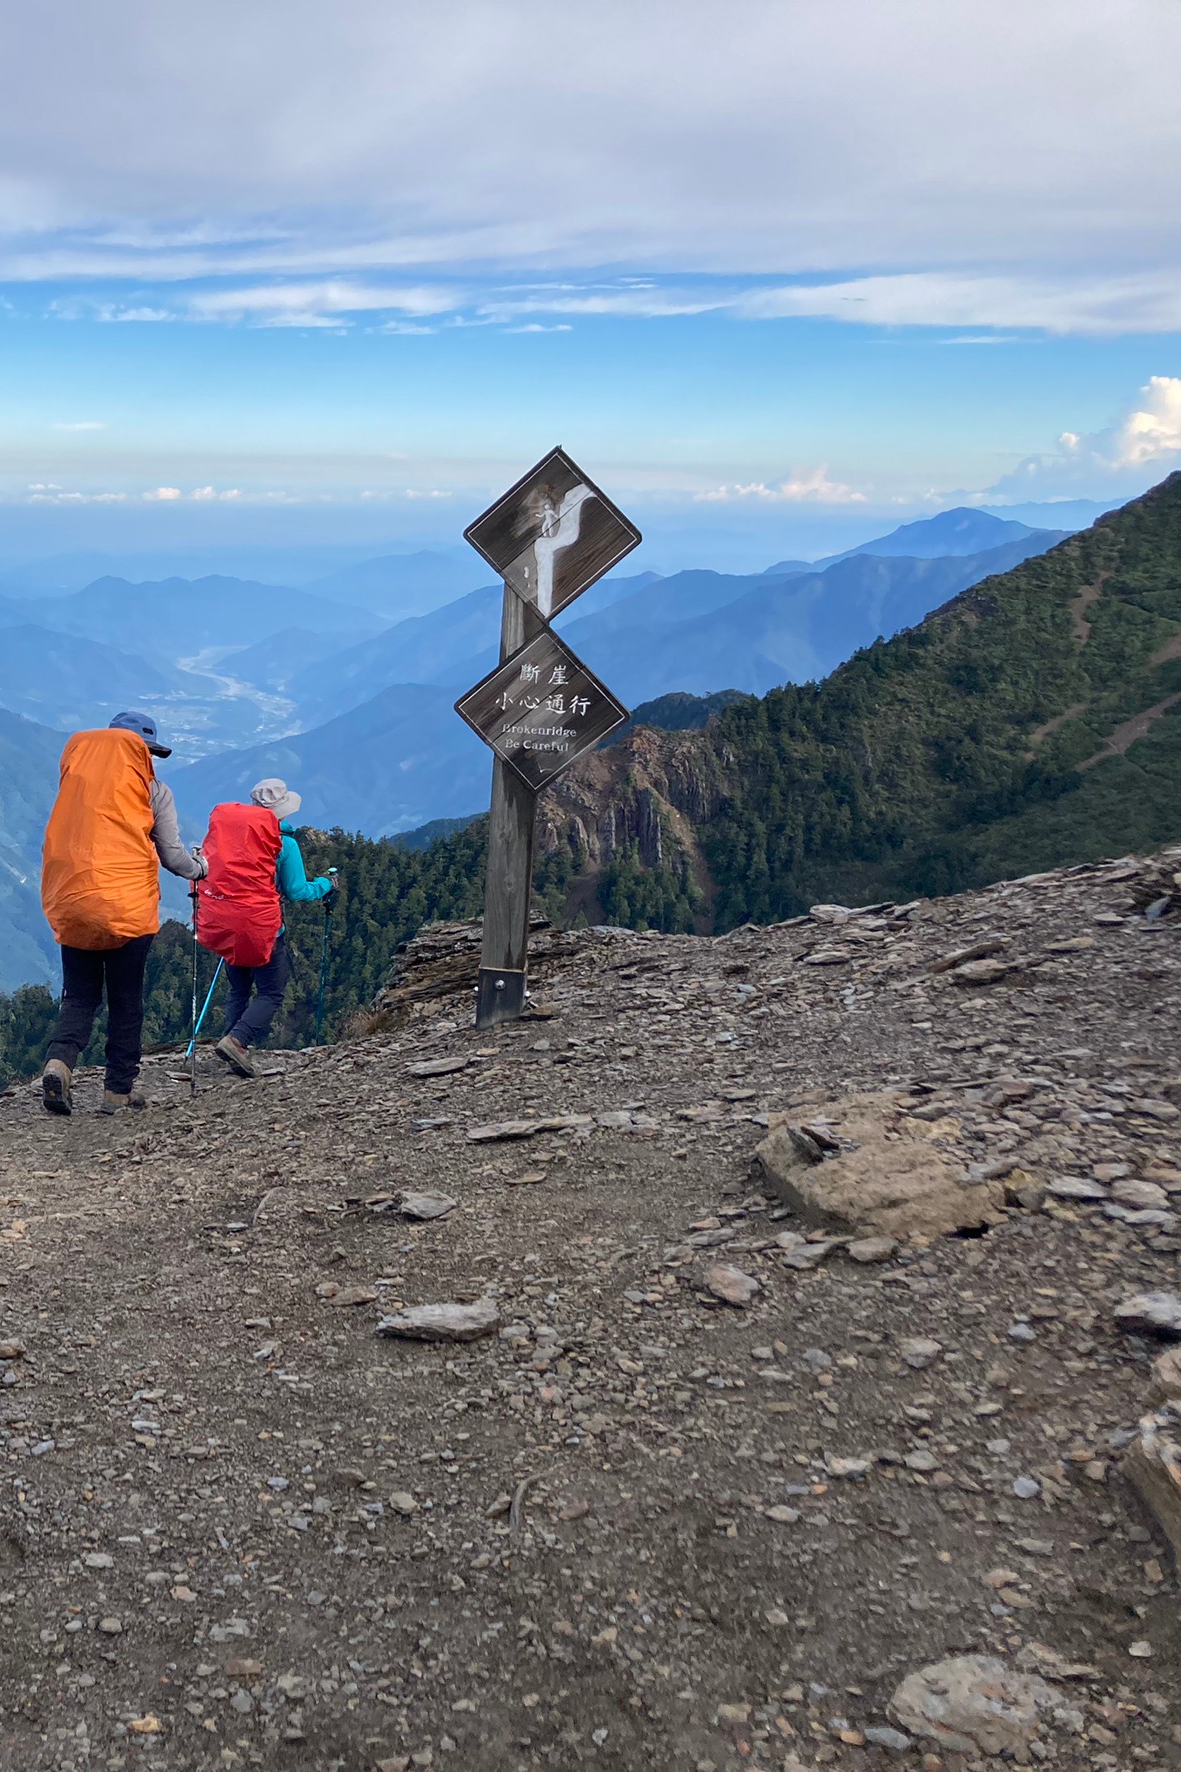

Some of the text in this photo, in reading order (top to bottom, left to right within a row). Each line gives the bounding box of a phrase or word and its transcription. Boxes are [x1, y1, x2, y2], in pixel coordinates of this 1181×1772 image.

[519, 663, 569, 685] 斷崖
[495, 692, 591, 717] 小心通行
[502, 723, 577, 738] Brokenridge
[505, 739, 569, 752] Be Careful
